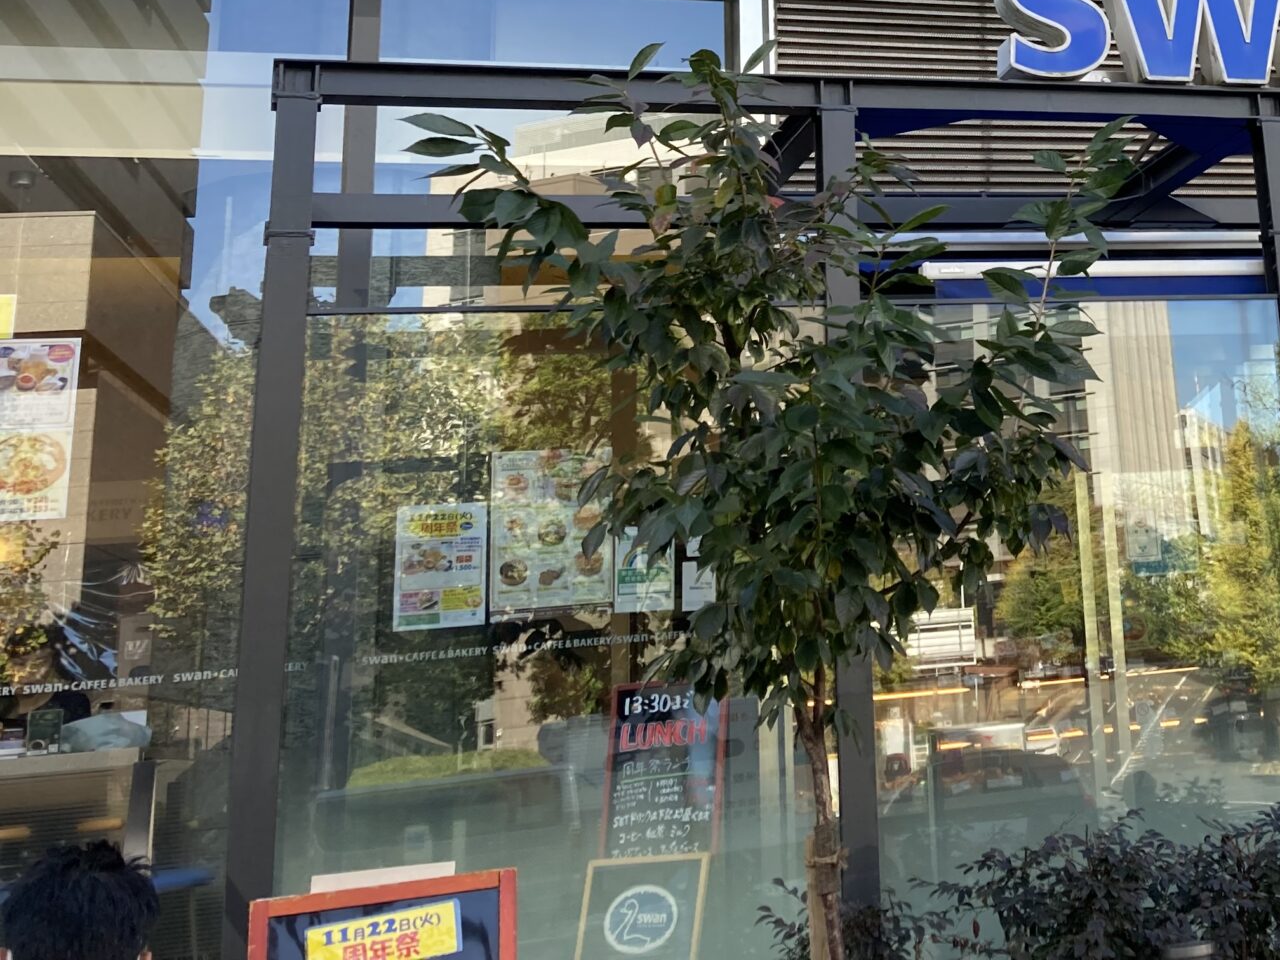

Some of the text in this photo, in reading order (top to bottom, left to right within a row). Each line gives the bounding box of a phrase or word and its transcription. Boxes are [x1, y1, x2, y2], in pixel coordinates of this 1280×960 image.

[620, 720, 707, 751] LUNCH
[323, 911, 441, 946] 11月22日(火)
[637, 913, 667, 924] swan
